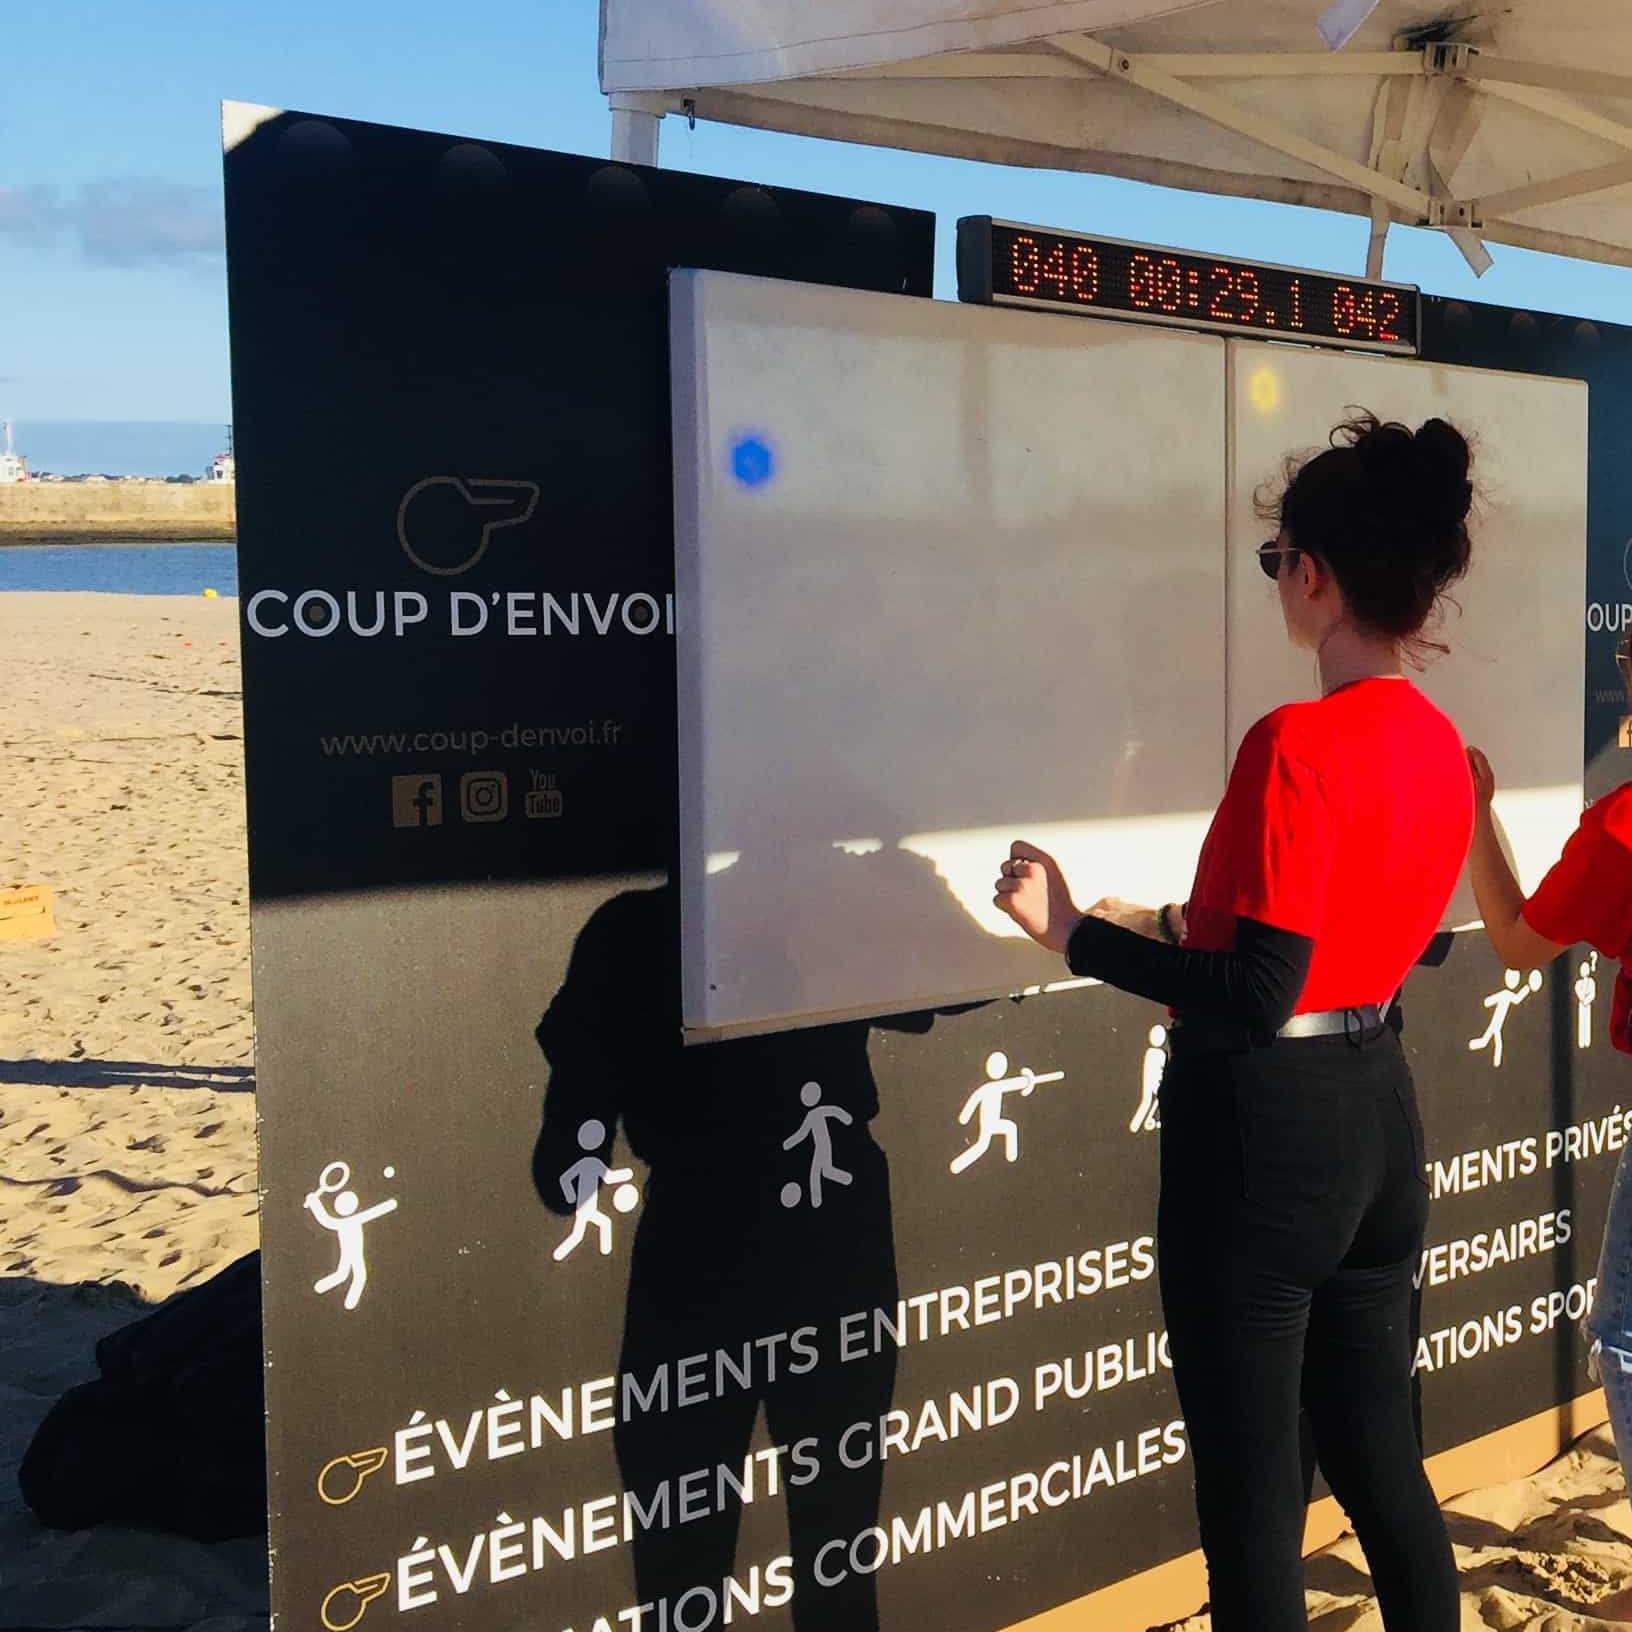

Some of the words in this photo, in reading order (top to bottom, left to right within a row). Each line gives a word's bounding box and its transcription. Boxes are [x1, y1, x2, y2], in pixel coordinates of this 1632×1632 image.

[1012, 236, 1098, 299] 040
[1333, 286, 1400, 341] 042
[247, 589, 428, 638] COUP
[450, 590, 674, 637] D'ENVOI
[320, 720, 623, 756] www.coup-denvoi.fr
[528, 793, 561, 817] Tube
[529, 768, 557, 790] You
[1412, 1209, 1572, 1290] VERSAIRES
[394, 1325, 820, 1485] ÉVÈNEMENTS
[839, 1236, 1155, 1362] ENTREPRISES
[1410, 1305, 1522, 1377] ATIONS
[397, 1437, 821, 1612] ÉVÈNEMENTS
[838, 1377, 1020, 1469] GRAND
[813, 1420, 1186, 1587] COMMERCIALES
